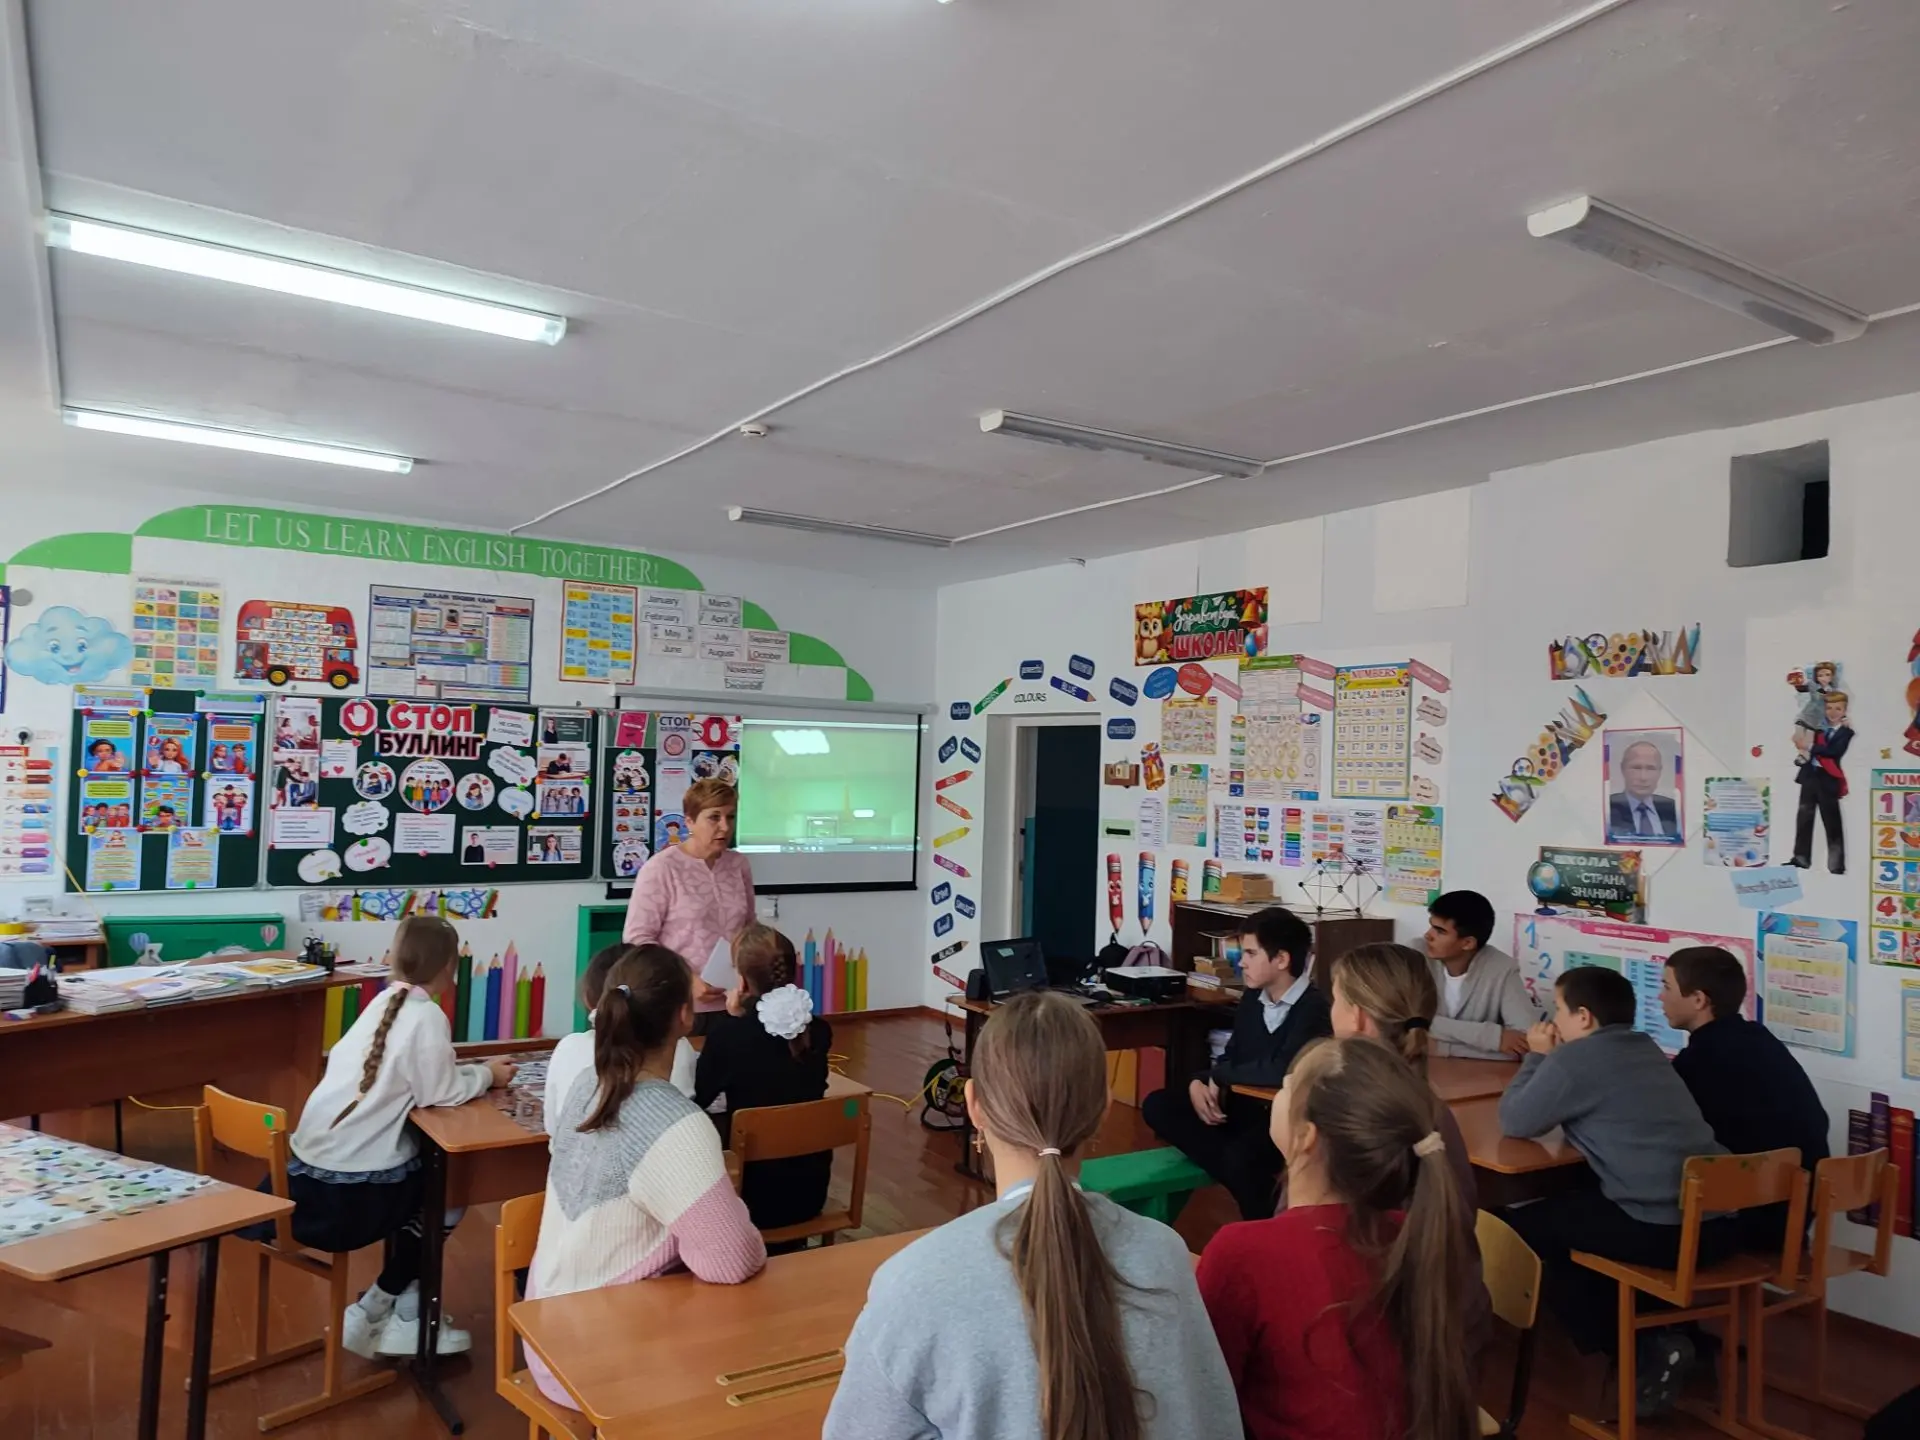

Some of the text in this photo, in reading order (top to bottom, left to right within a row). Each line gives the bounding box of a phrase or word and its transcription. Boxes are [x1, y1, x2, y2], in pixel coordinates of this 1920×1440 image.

[204, 508, 660, 584] LET US LEARN ENGLISH TOGETHER!
[647, 595, 680, 607] January
[708, 598, 733, 608] March
[644, 611, 680, 624] February
[711, 614, 729, 624] April
[664, 629, 682, 640] May
[714, 633, 730, 642] July
[661, 644, 683, 654] June
[1173, 629, 1245, 660] ШКОЛА!
[707, 648, 736, 659] August
[752, 650, 783, 661] October
[1350, 668, 1398, 680] NUMBERS
[1060, 681, 1078, 696] BLUE
[1013, 692, 1048, 704] COLOURS
[389, 703, 474, 732] СТОП
[659, 716, 691, 727] СТОП
[377, 731, 485, 758] БУЛЛИНГ
[1879, 792, 1894, 814] 1
[1877, 814, 1897, 822] ONE
[1878, 826, 1897, 849] 2
[1877, 849, 1900, 857] TWO
[1879, 860, 1899, 882] 3
[1581, 872, 1627, 887] СТРАНА
[1876, 896, 1898, 917] 4
[1875, 917, 1901, 926] FOUR
[1525, 919, 1537, 949] 1
[1877, 930, 1899, 952] 5
[938, 945, 956, 960] BLACK
[1877, 952, 1899, 961] FIVE
[1538, 952, 1553, 979] 2
